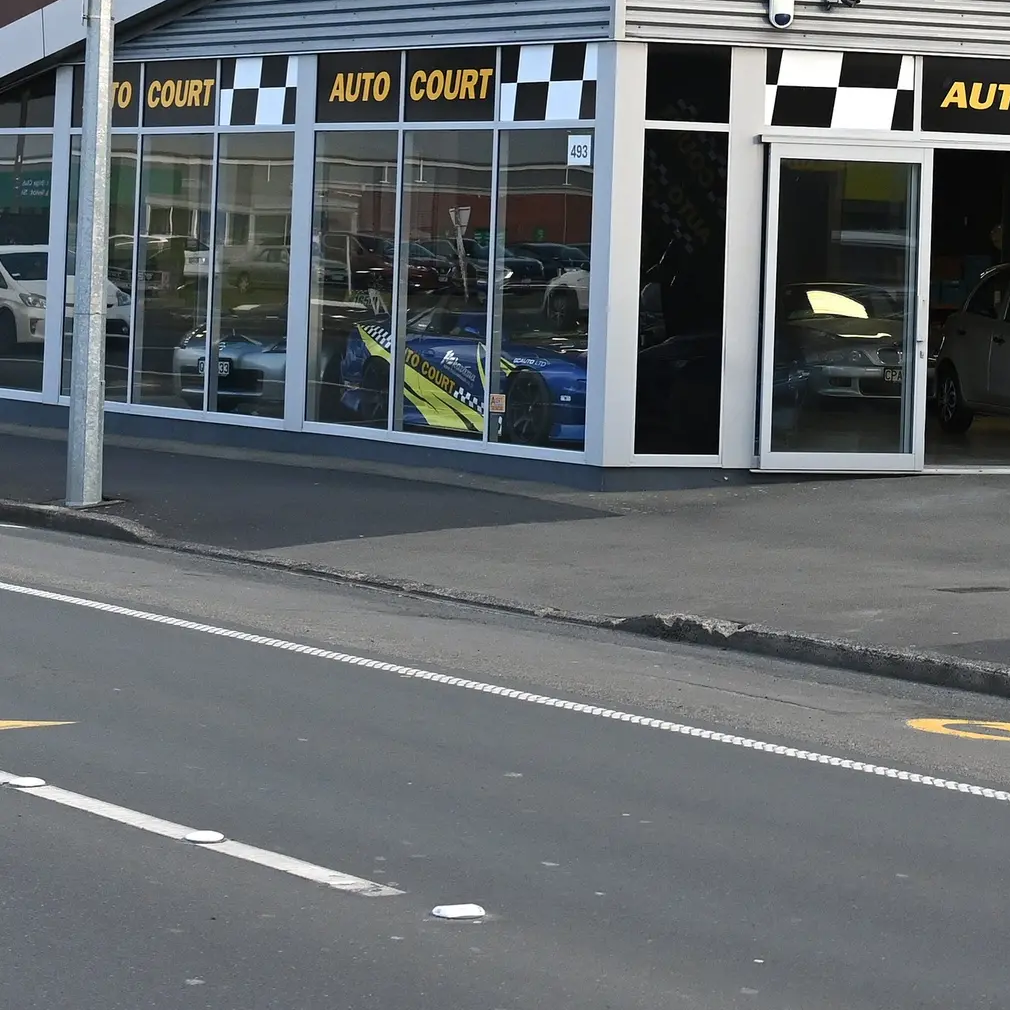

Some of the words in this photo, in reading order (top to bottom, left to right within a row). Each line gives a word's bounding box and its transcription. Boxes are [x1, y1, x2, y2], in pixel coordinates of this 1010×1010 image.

[112, 81, 132, 109] TO
[147, 79, 215, 108] COURT
[328, 71, 391, 102] AUTO
[409, 68, 493, 101] COURT
[570, 145, 588, 158] 493
[421, 361, 456, 393] COURT
